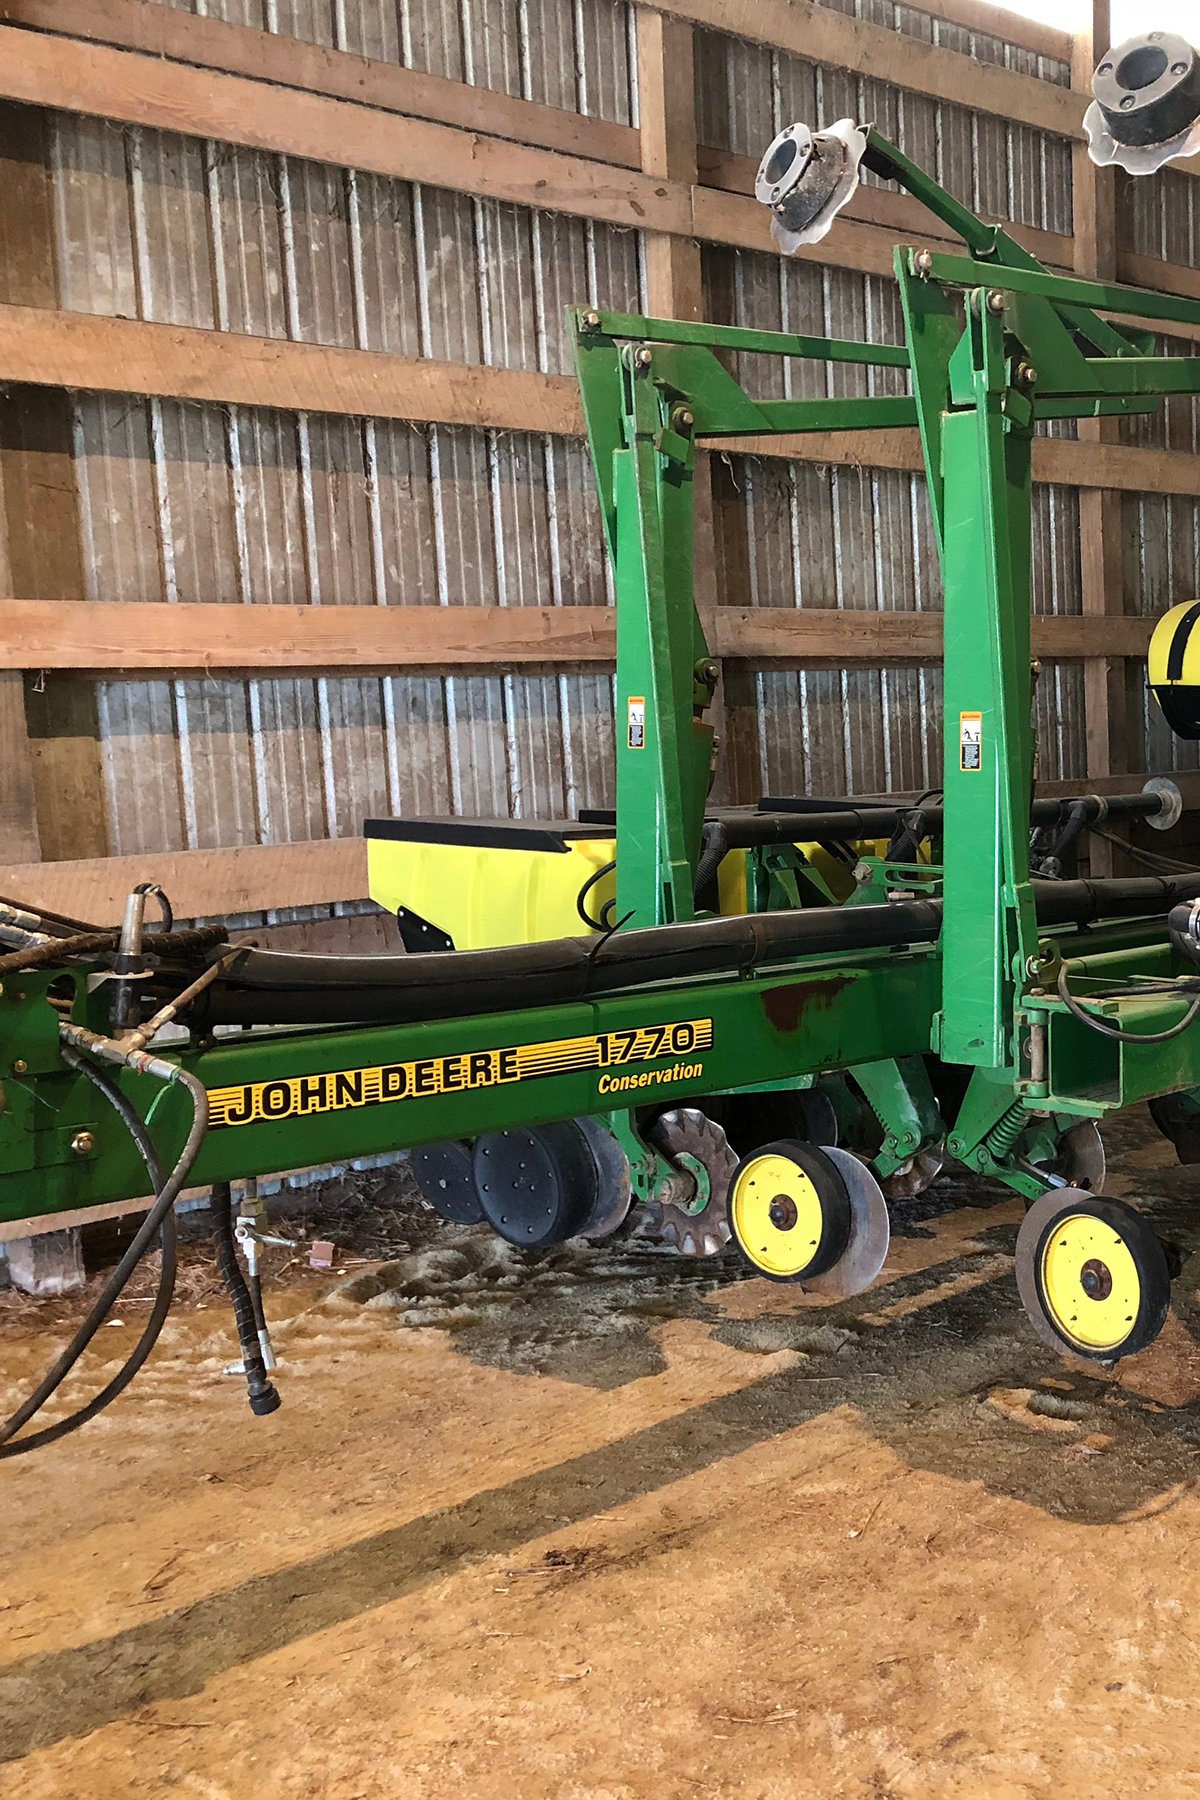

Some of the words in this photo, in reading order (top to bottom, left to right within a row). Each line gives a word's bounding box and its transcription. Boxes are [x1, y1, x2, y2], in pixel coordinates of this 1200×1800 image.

[225, 1070, 364, 1126] JOHN
[380, 1048, 521, 1101] DEERE
[593, 1022, 699, 1066] 1770
[597, 1061, 704, 1096] Conservation
